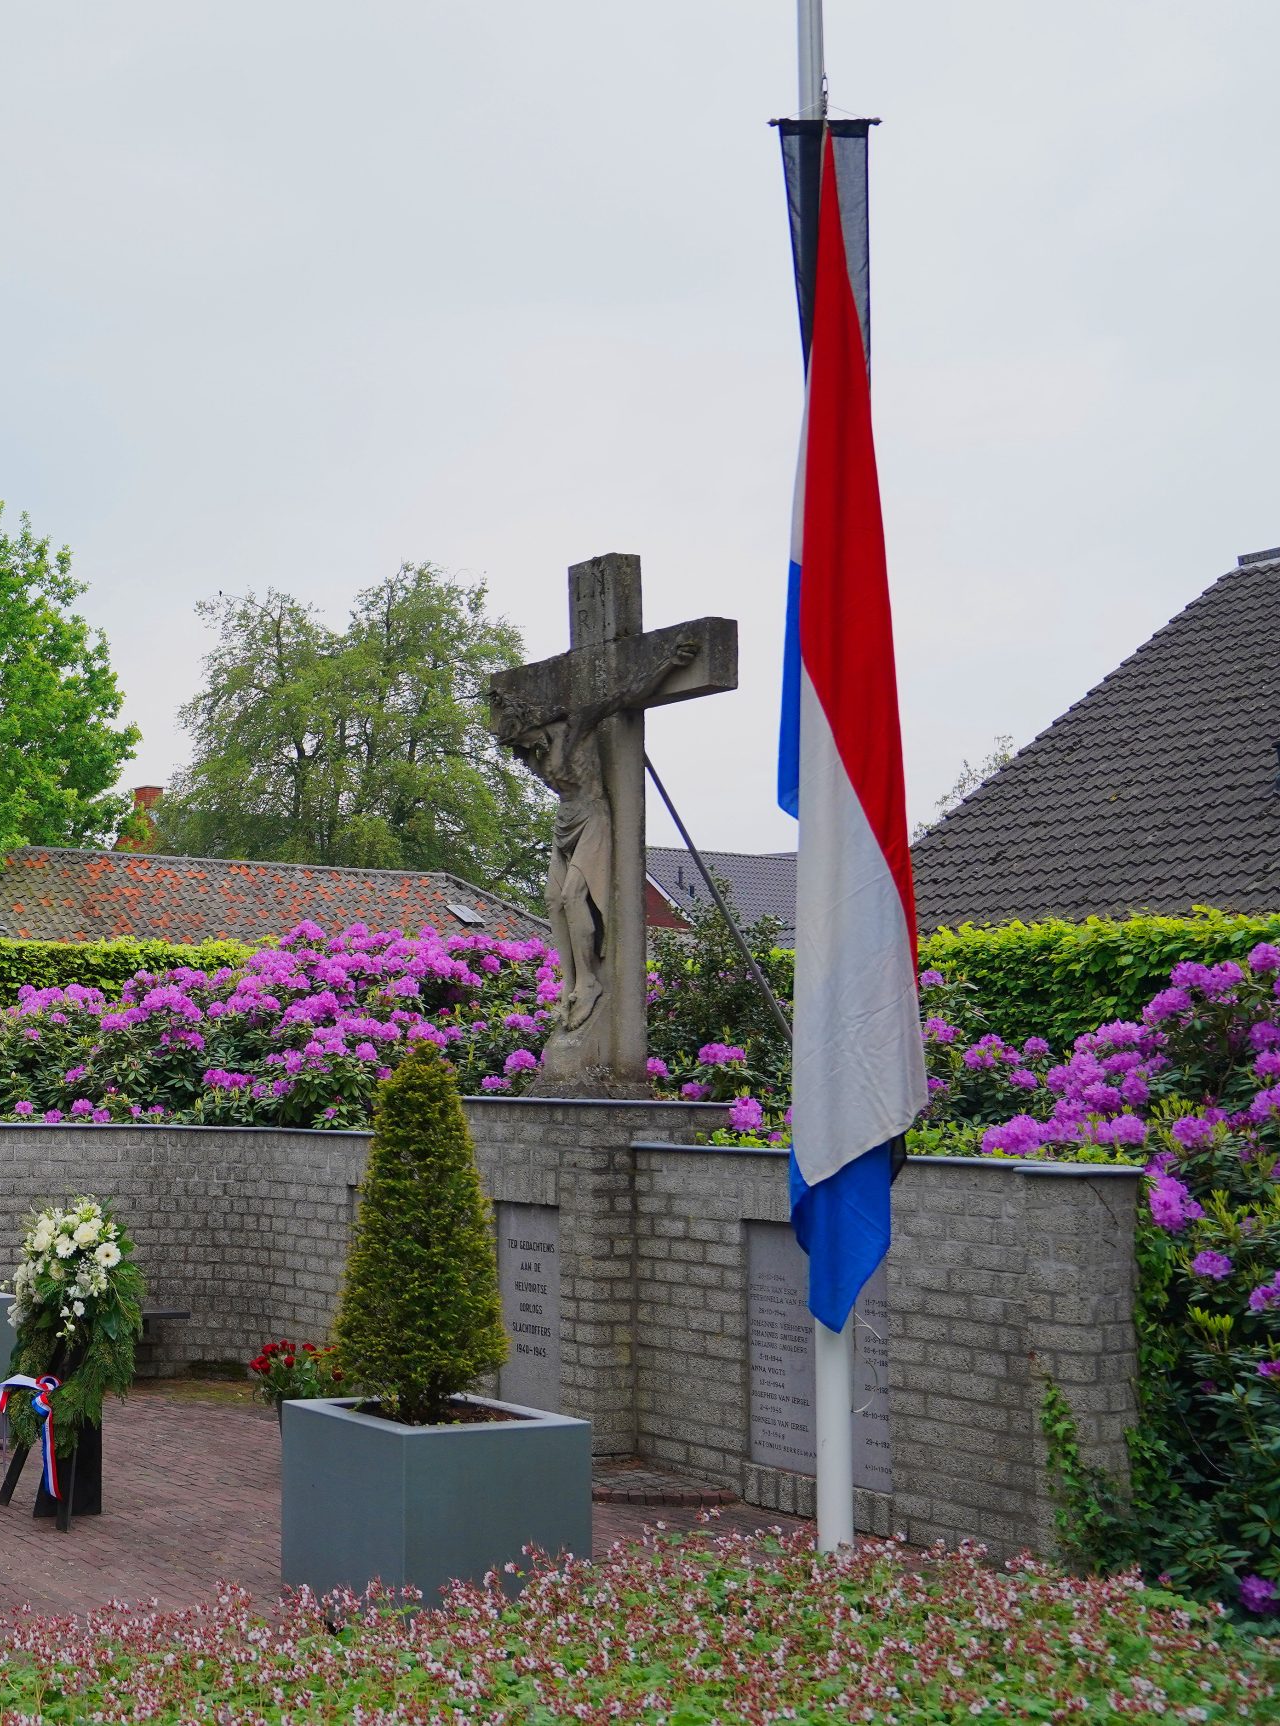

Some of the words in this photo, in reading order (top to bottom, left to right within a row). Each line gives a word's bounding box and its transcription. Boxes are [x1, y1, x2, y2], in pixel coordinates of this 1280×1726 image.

[507, 1238, 518, 1249] TER
[520, 1261, 532, 1271] AAN
[533, 1262, 541, 1273] DE
[519, 1302, 543, 1315] OORLOGS
[512, 1321, 552, 1338] SLACHTOFFERS
[516, 1343, 546, 1358] 1940-1945
[751, 1364, 767, 1373] ANNA
[778, 1394, 790, 1403] VAN
[777, 1419, 790, 1429] VAN
